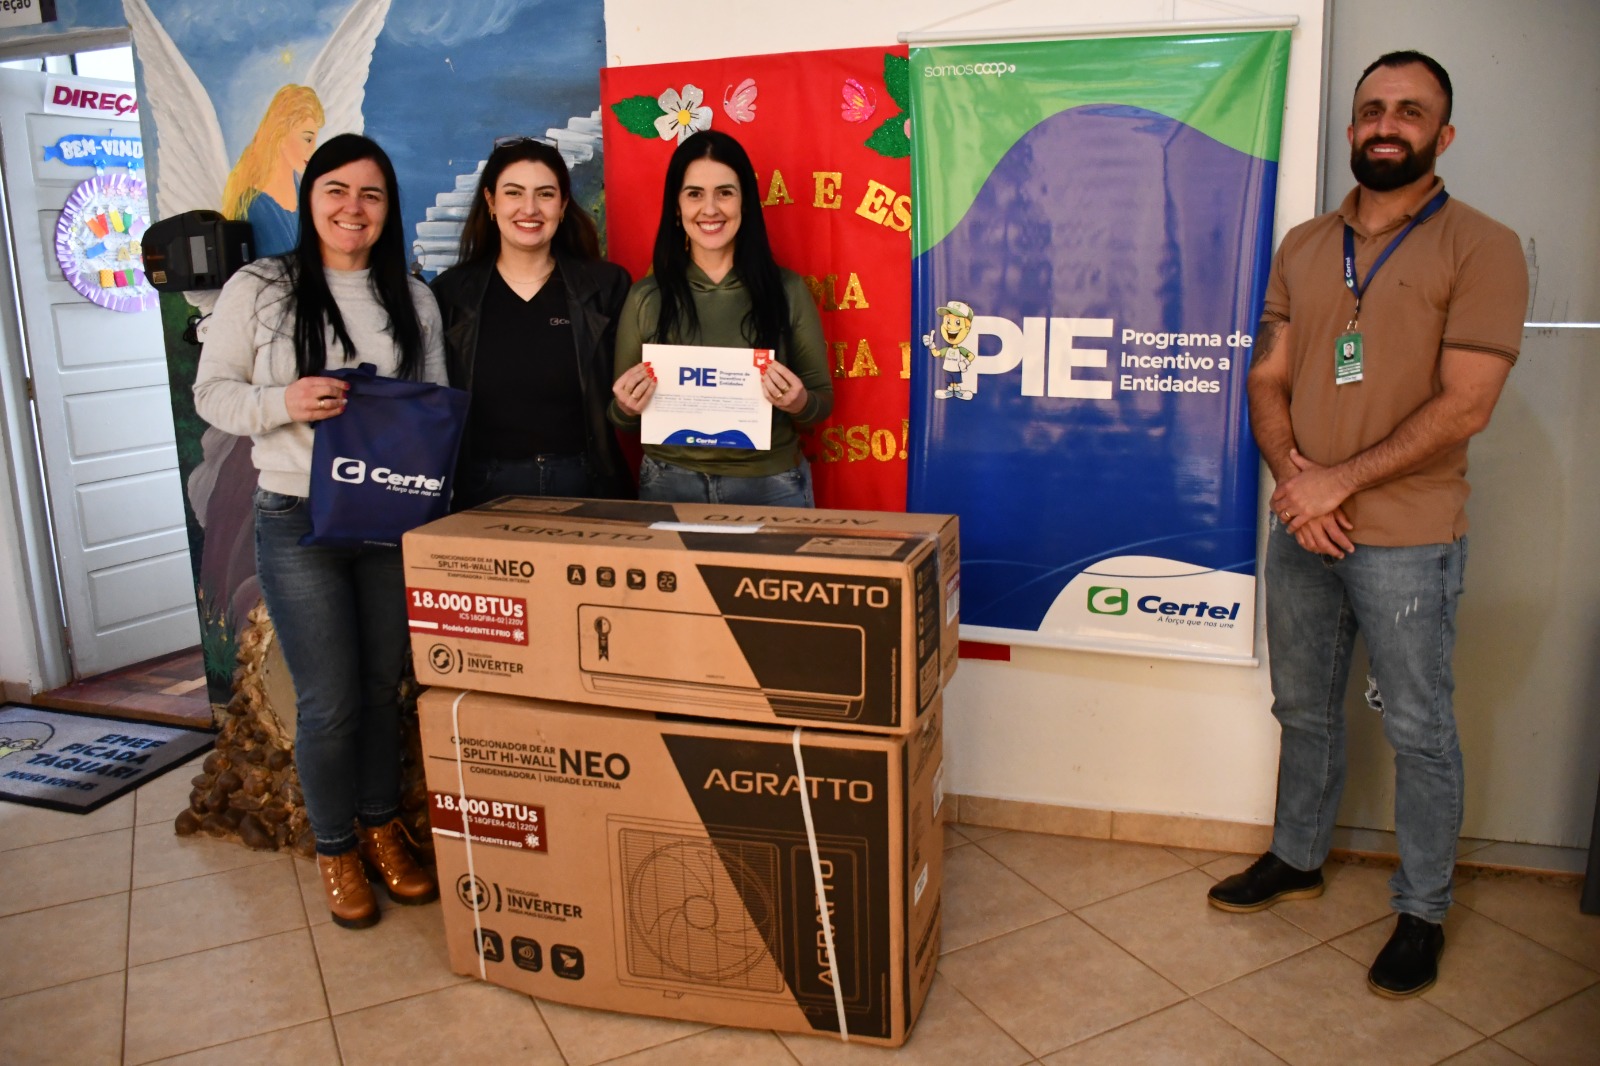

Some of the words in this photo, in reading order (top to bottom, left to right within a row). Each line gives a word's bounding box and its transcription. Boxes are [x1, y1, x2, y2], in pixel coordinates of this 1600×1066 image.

[924, 62, 1007, 77] somoscoop
[1121, 329, 1221, 351] Programa
[1226, 331, 1253, 348] de
[963, 315, 1114, 400] PIE
[1120, 352, 1214, 370] Incentivo
[1218, 356, 1231, 370] a
[679, 366, 717, 387] PIE
[1120, 375, 1220, 393] Entidades
[370, 467, 445, 490] Certel
[484, 523, 655, 541] AGRATTO
[438, 561, 459, 569] SPLIT
[460, 562, 493, 571] HI-WALL
[494, 558, 535, 578] NEO
[734, 576, 889, 609] AGRATTO
[412, 590, 472, 613] 18.000
[475, 596, 524, 618] BTUs
[1137, 595, 1240, 620] Certel
[442, 623, 464, 632] Modelo
[464, 625, 489, 636] QUENTE
[495, 629, 511, 638] FRIO
[1165, 616, 1184, 625] força
[468, 657, 524, 674] INVERTER
[95, 734, 167, 749] EMEF
[59, 743, 152, 765] PICADA
[463, 747, 497, 762] SPLIT
[500, 752, 557, 768] HI-WALL
[529, 744, 542, 753] DE
[543, 745, 556, 754] AR
[560, 748, 631, 781] NEO
[26, 753, 141, 779] TAQUARI
[470, 766, 536, 781] CONDENSADORA
[544, 775, 581, 786] UNIDADE
[582, 779, 621, 790] EXTERNA
[703, 768, 874, 803] AGRATTO
[492, 801, 538, 823] BTUs
[520, 823, 538, 832] 220V
[479, 836, 504, 845] QUENTE
[508, 840, 523, 848] FRIO
[507, 894, 583, 919] INVERTER
[482, 936, 497, 955] A
